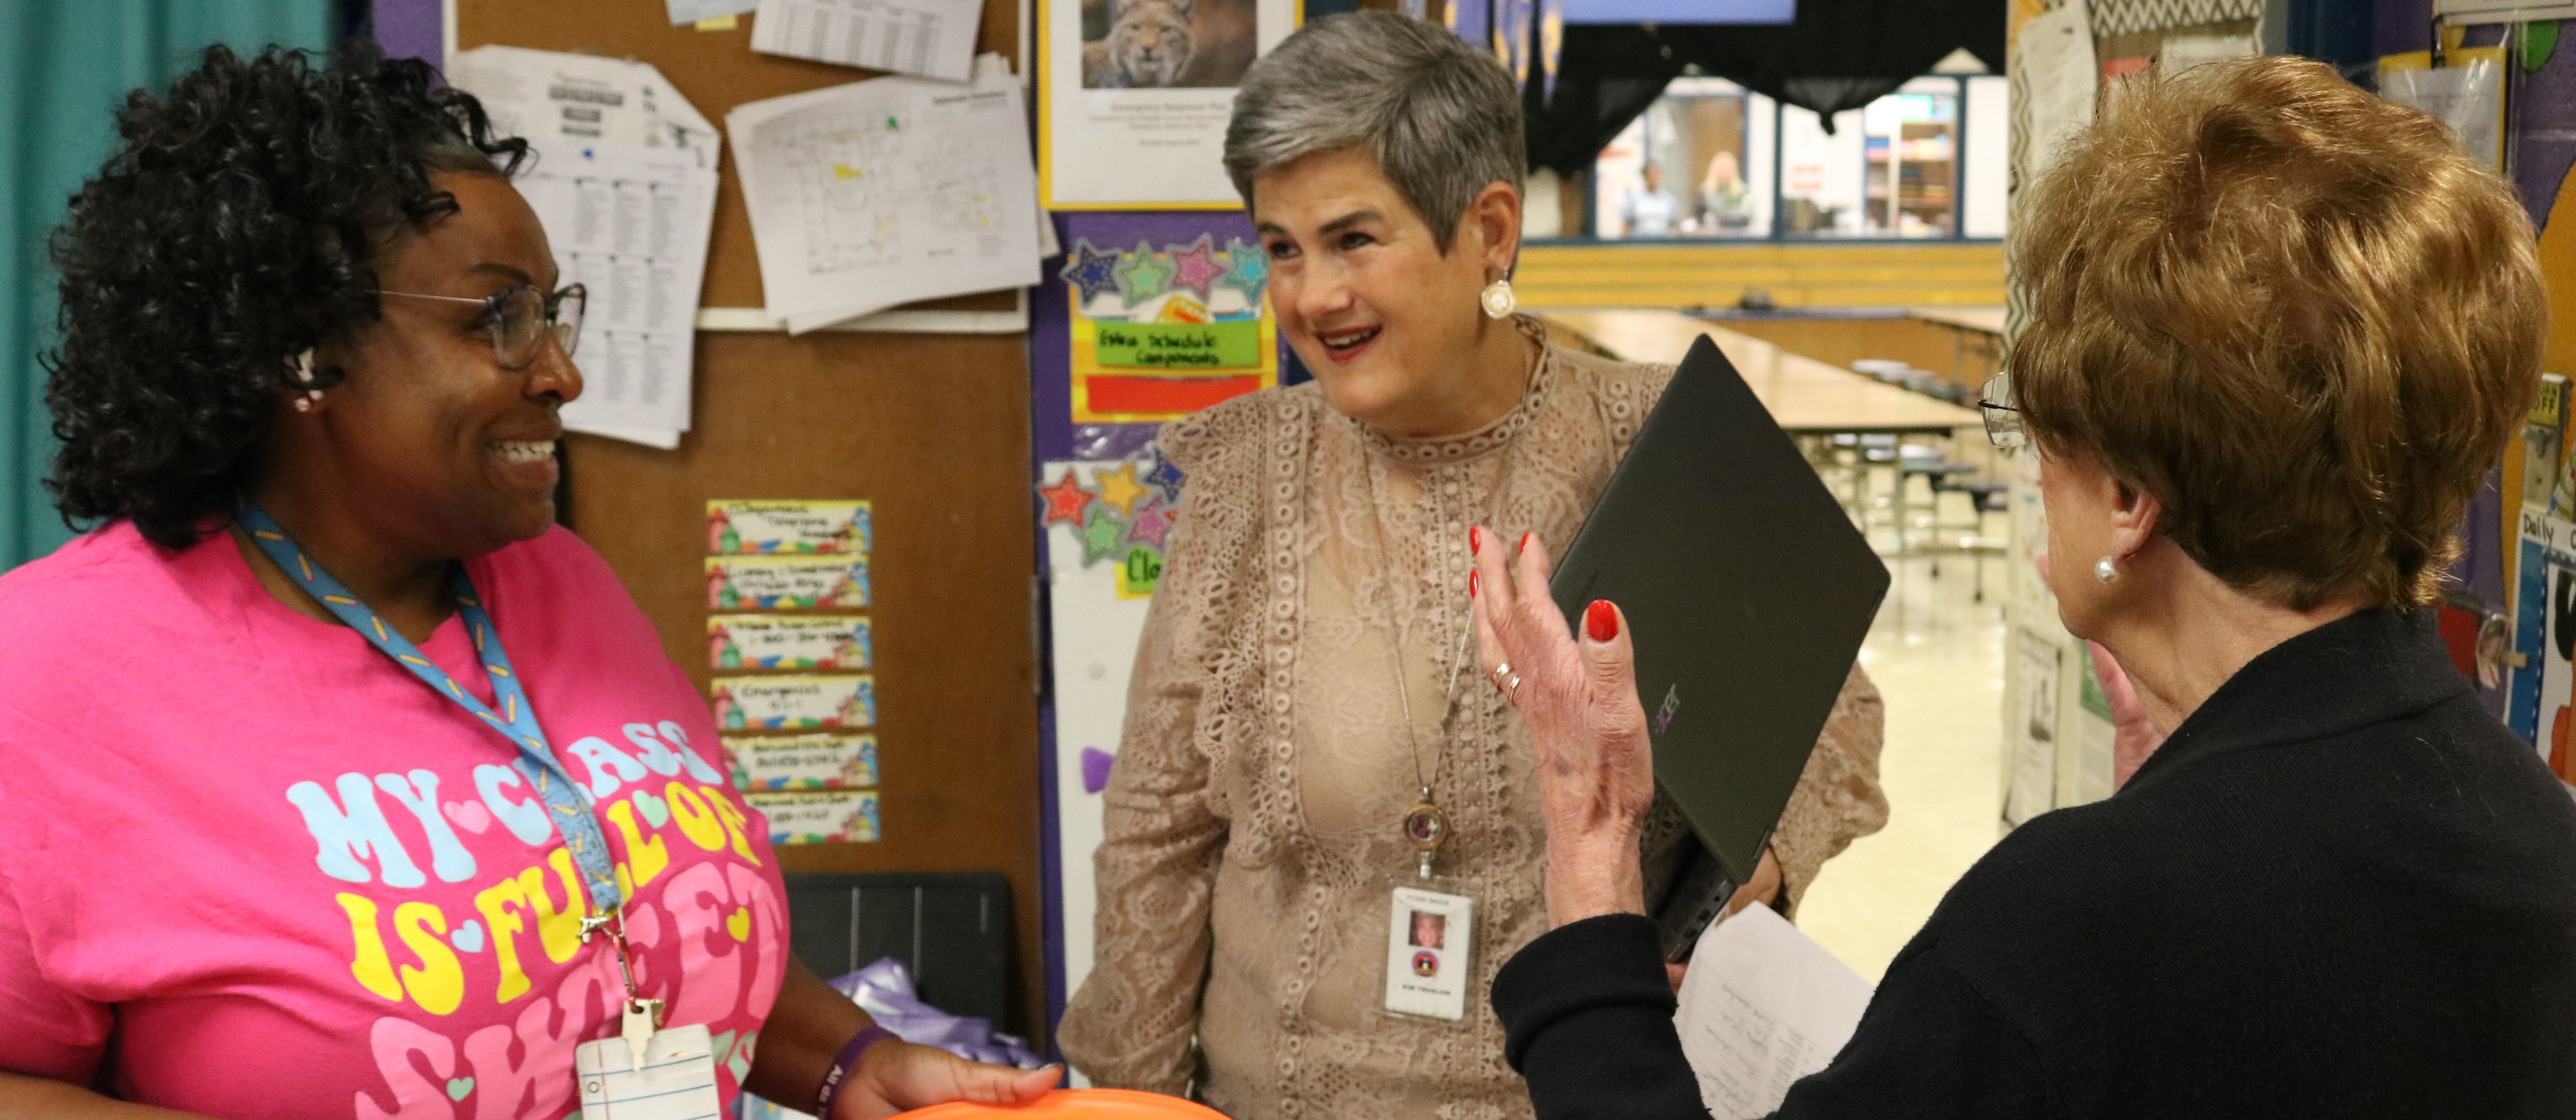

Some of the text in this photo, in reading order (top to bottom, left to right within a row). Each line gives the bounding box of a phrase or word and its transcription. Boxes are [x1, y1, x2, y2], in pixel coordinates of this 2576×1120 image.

[2523, 513, 2554, 551] Daily
[286, 769, 477, 888] MY
[336, 892, 464, 1015] IS
[665, 781, 762, 867] OF
